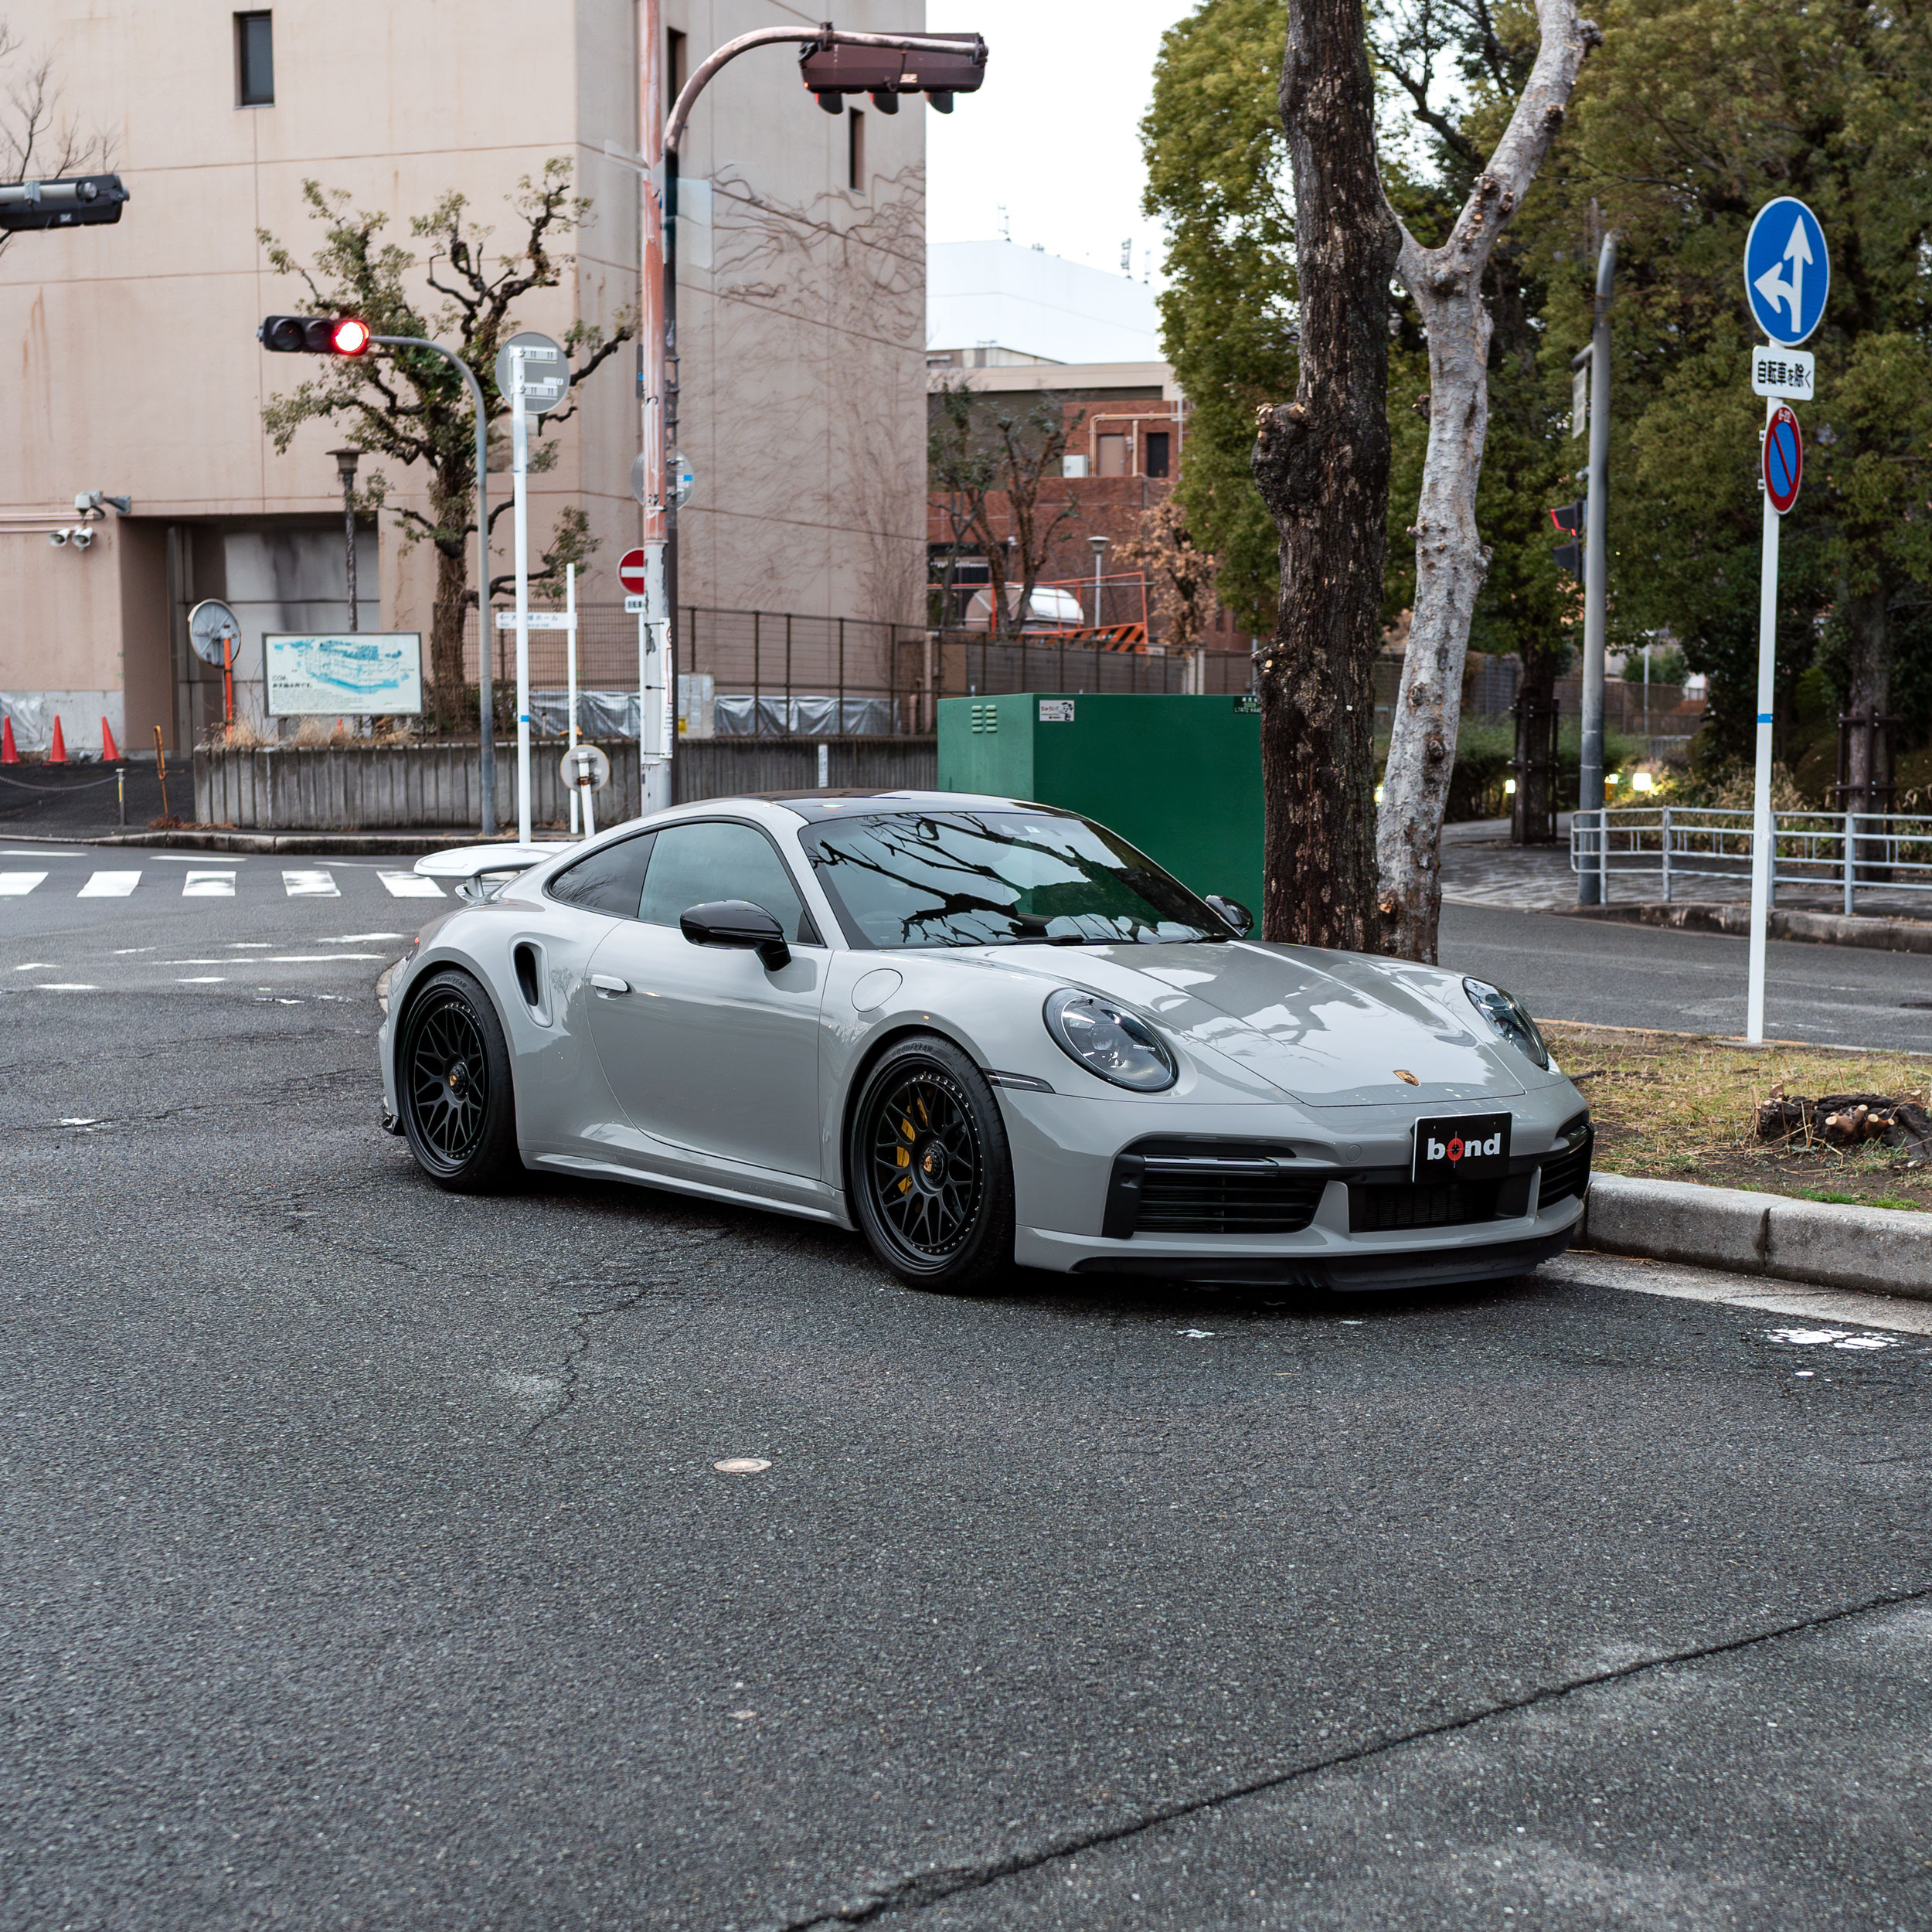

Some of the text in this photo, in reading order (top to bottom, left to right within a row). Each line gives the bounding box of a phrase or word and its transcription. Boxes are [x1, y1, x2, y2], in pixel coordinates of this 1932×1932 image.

[1758, 360, 1811, 388] 自転車を除く
[892, 1043, 933, 1056] GOODYEAR
[1427, 1132, 1501, 1162] bond
